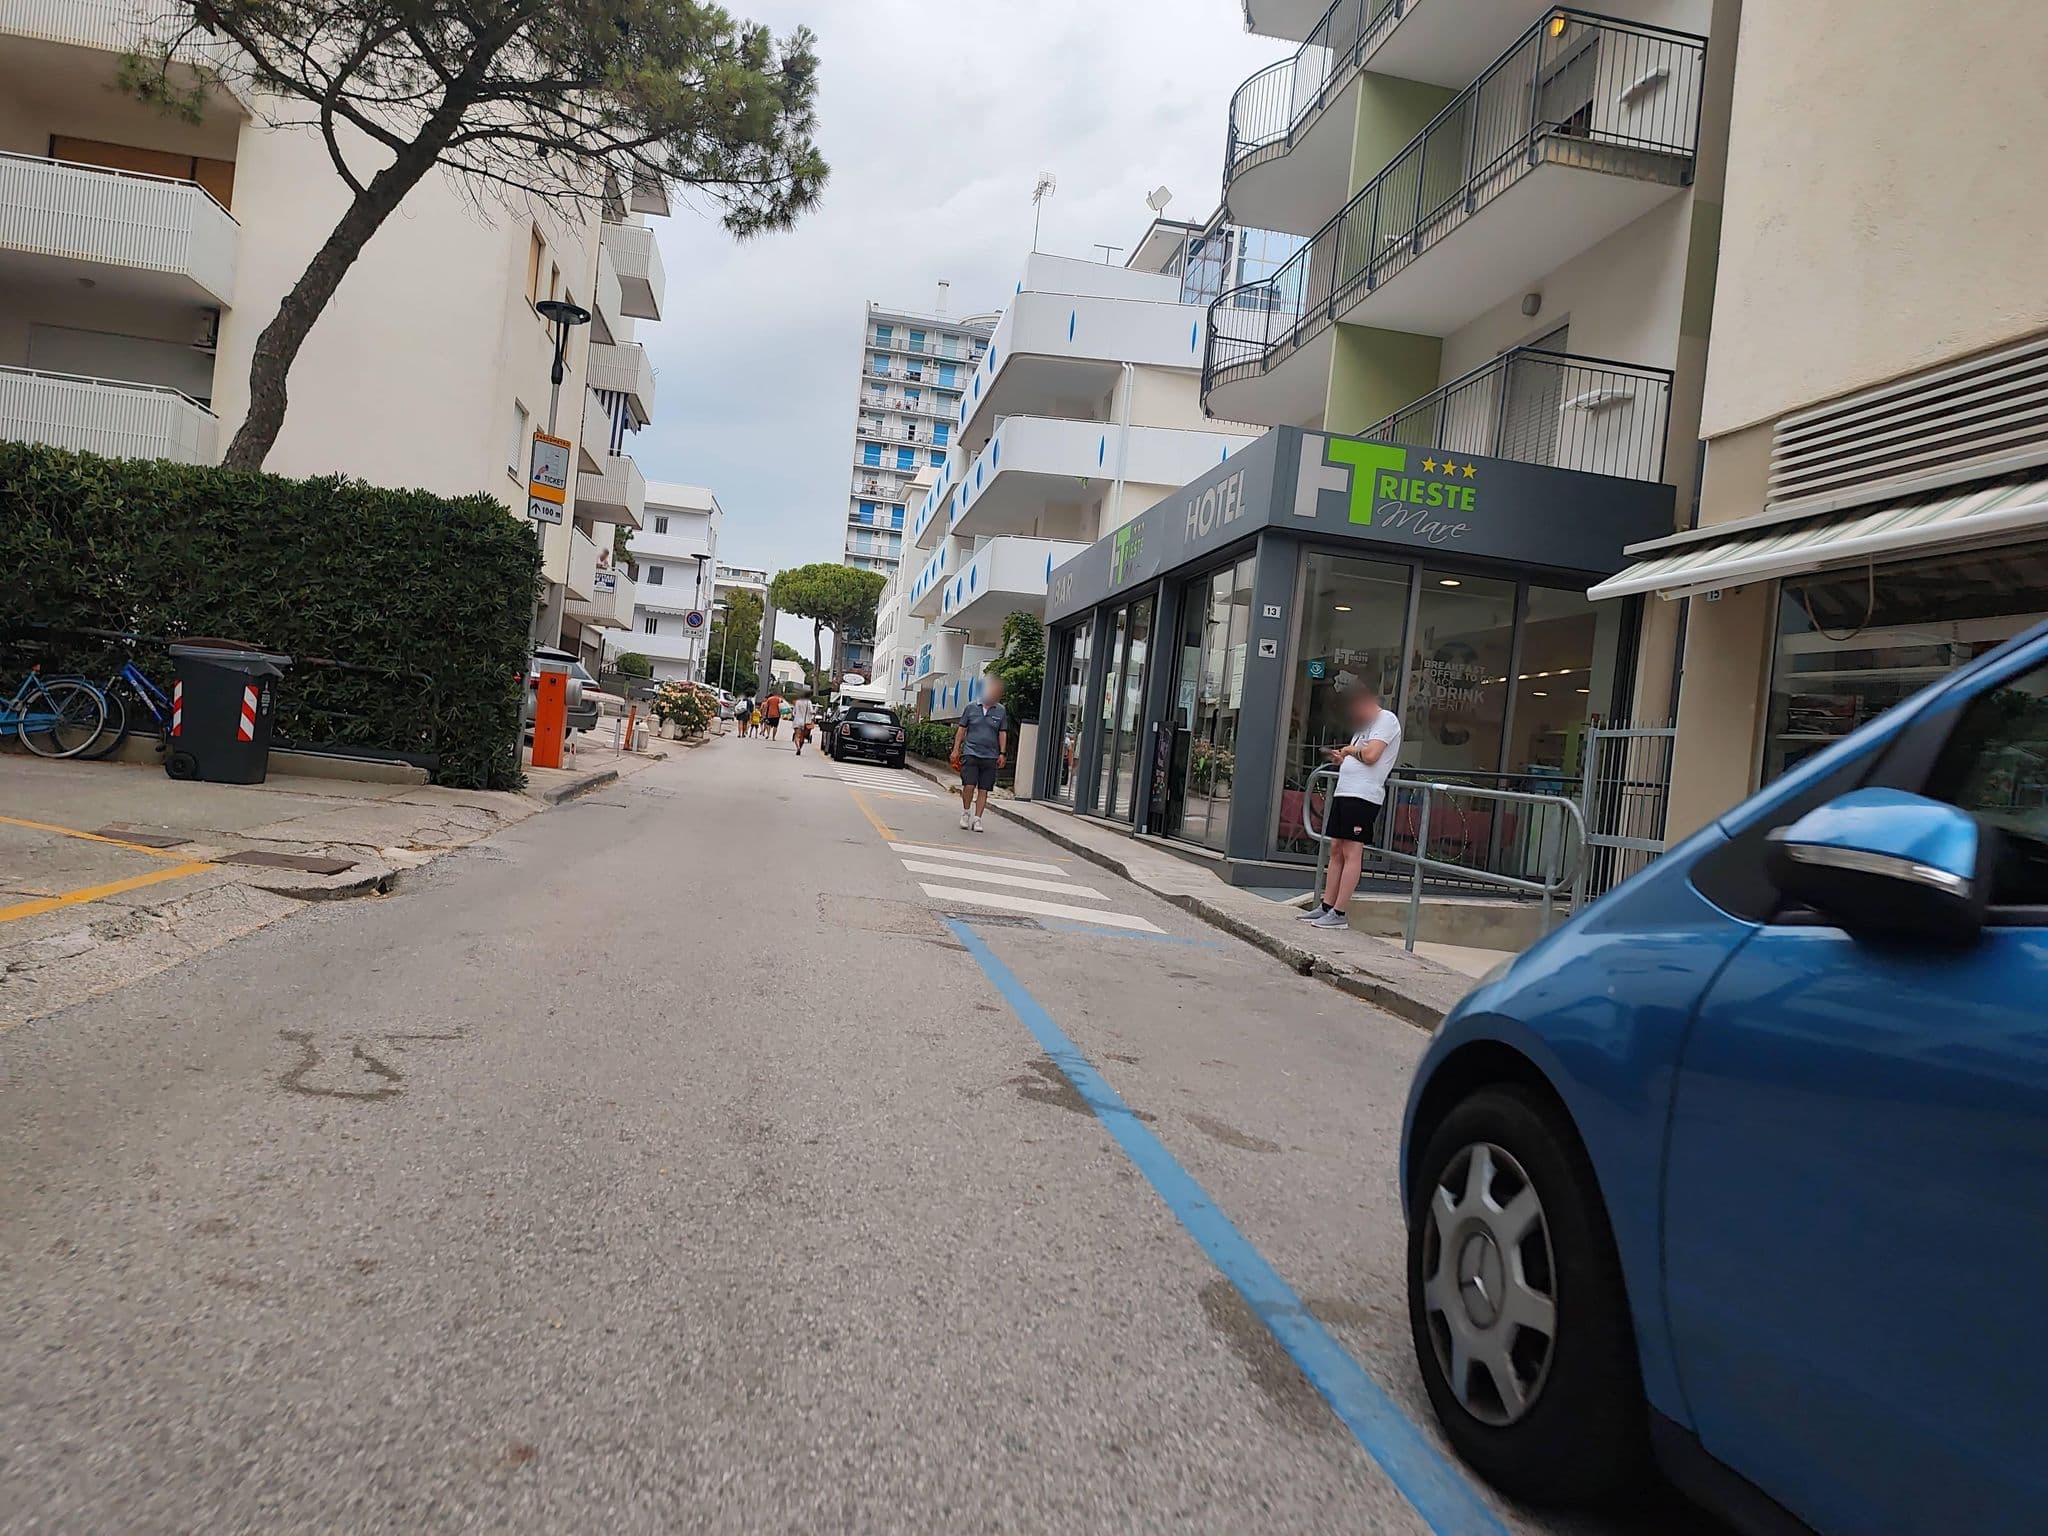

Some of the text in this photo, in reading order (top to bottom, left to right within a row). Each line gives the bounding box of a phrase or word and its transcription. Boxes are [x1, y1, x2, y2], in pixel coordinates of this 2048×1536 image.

[544, 475, 564, 486] TICKET
[542, 506, 554, 517] 100
[1184, 468, 1246, 545] HOTEL
[1377, 501, 1472, 543] Mare
[1054, 573, 1073, 608] BAR
[1267, 607, 1277, 616] 13
[1423, 660, 1486, 675] BREAKFAST
[1465, 673, 1477, 682] TO
[1436, 685, 1486, 704] DRINK
